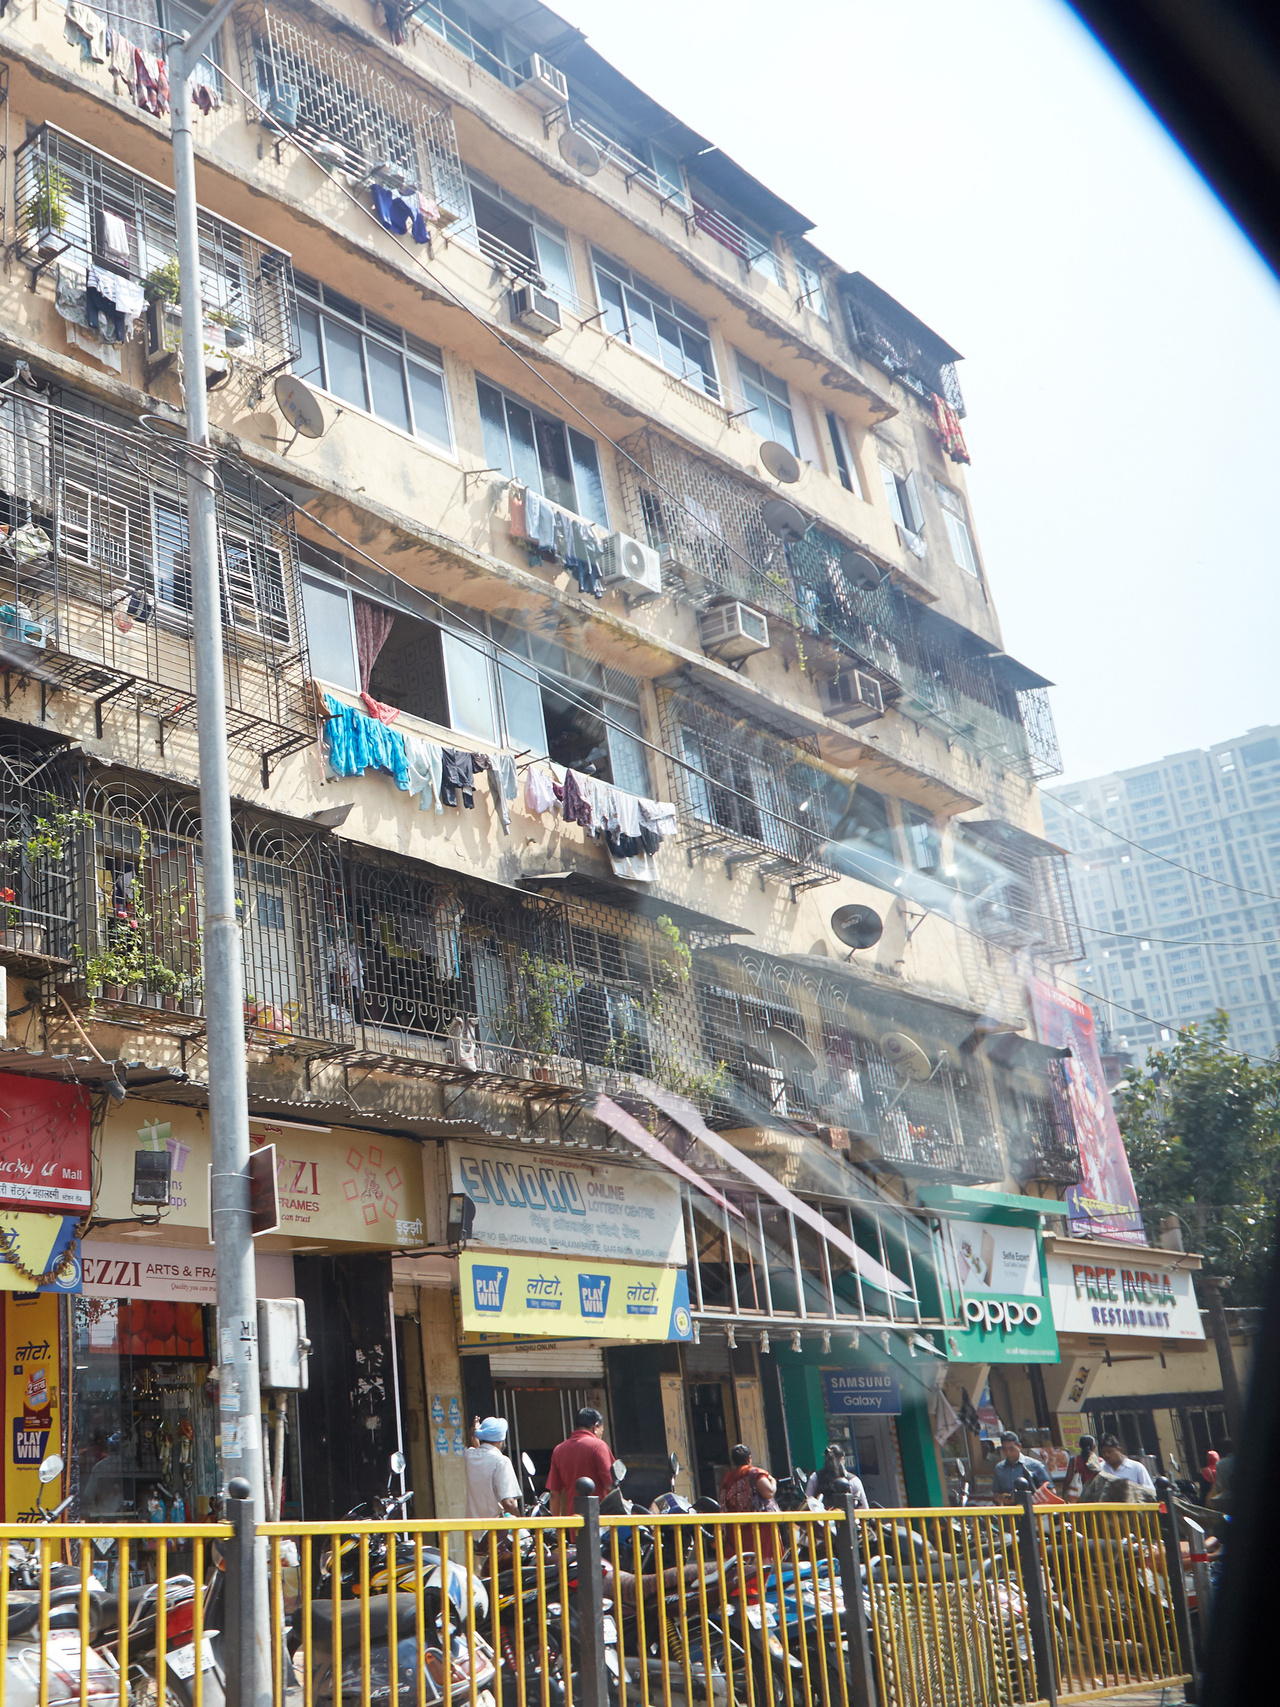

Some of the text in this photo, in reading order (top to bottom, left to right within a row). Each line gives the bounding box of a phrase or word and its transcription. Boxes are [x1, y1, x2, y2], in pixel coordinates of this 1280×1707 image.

[61, 1168, 83, 1181] Mall
[460, 1156, 587, 1216] SINDHU
[587, 1181, 625, 1201] ONLINE
[588, 1200, 623, 1216] LOTTERY
[146, 1263, 179, 1276] ARTS
[182, 1265, 192, 1277] &
[195, 1267, 217, 1278] FRA
[171, 1283, 189, 1292] Quality
[476, 1277, 500, 1293] PLAY
[527, 1274, 563, 1296] लोटो.
[582, 1285, 603, 1301] PLAY
[627, 1281, 659, 1302] लोटो.
[1072, 1264, 1177, 1307] FREE INDIA
[477, 1293, 500, 1307] WIN
[583, 1300, 604, 1313] WIN
[964, 1298, 1042, 1333] oppo
[1091, 1306, 1171, 1329] RESTAURANT
[15, 1340, 52, 1361] लोटो.
[830, 1376, 892, 1389] SAMSUNG
[843, 1395, 882, 1409] Galaxy
[16, 1431, 41, 1445] PLAY
[17, 1445, 40, 1459] WIN
